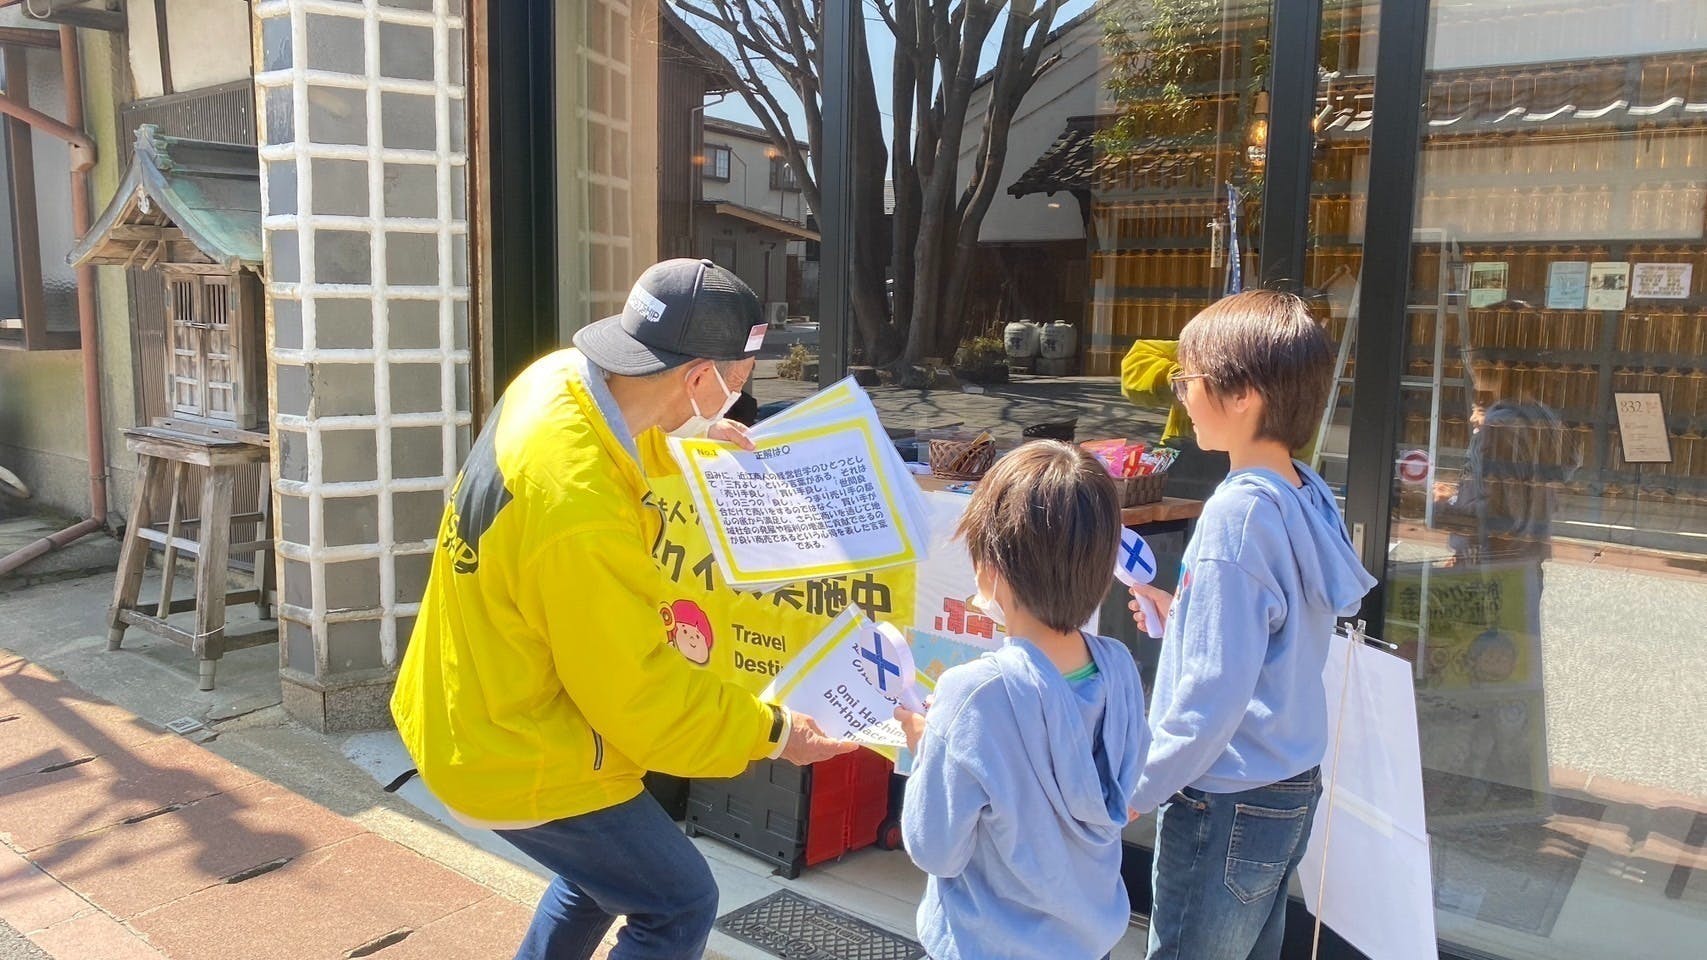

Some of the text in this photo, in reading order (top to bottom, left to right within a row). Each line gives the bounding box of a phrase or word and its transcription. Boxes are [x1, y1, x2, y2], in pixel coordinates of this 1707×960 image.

[697, 448, 718, 457] No.1
[732, 623, 786, 652] Travel
[734, 650, 784, 676] Desti
[837, 684, 860, 708] Omi
[824, 689, 887, 741] birthplace
